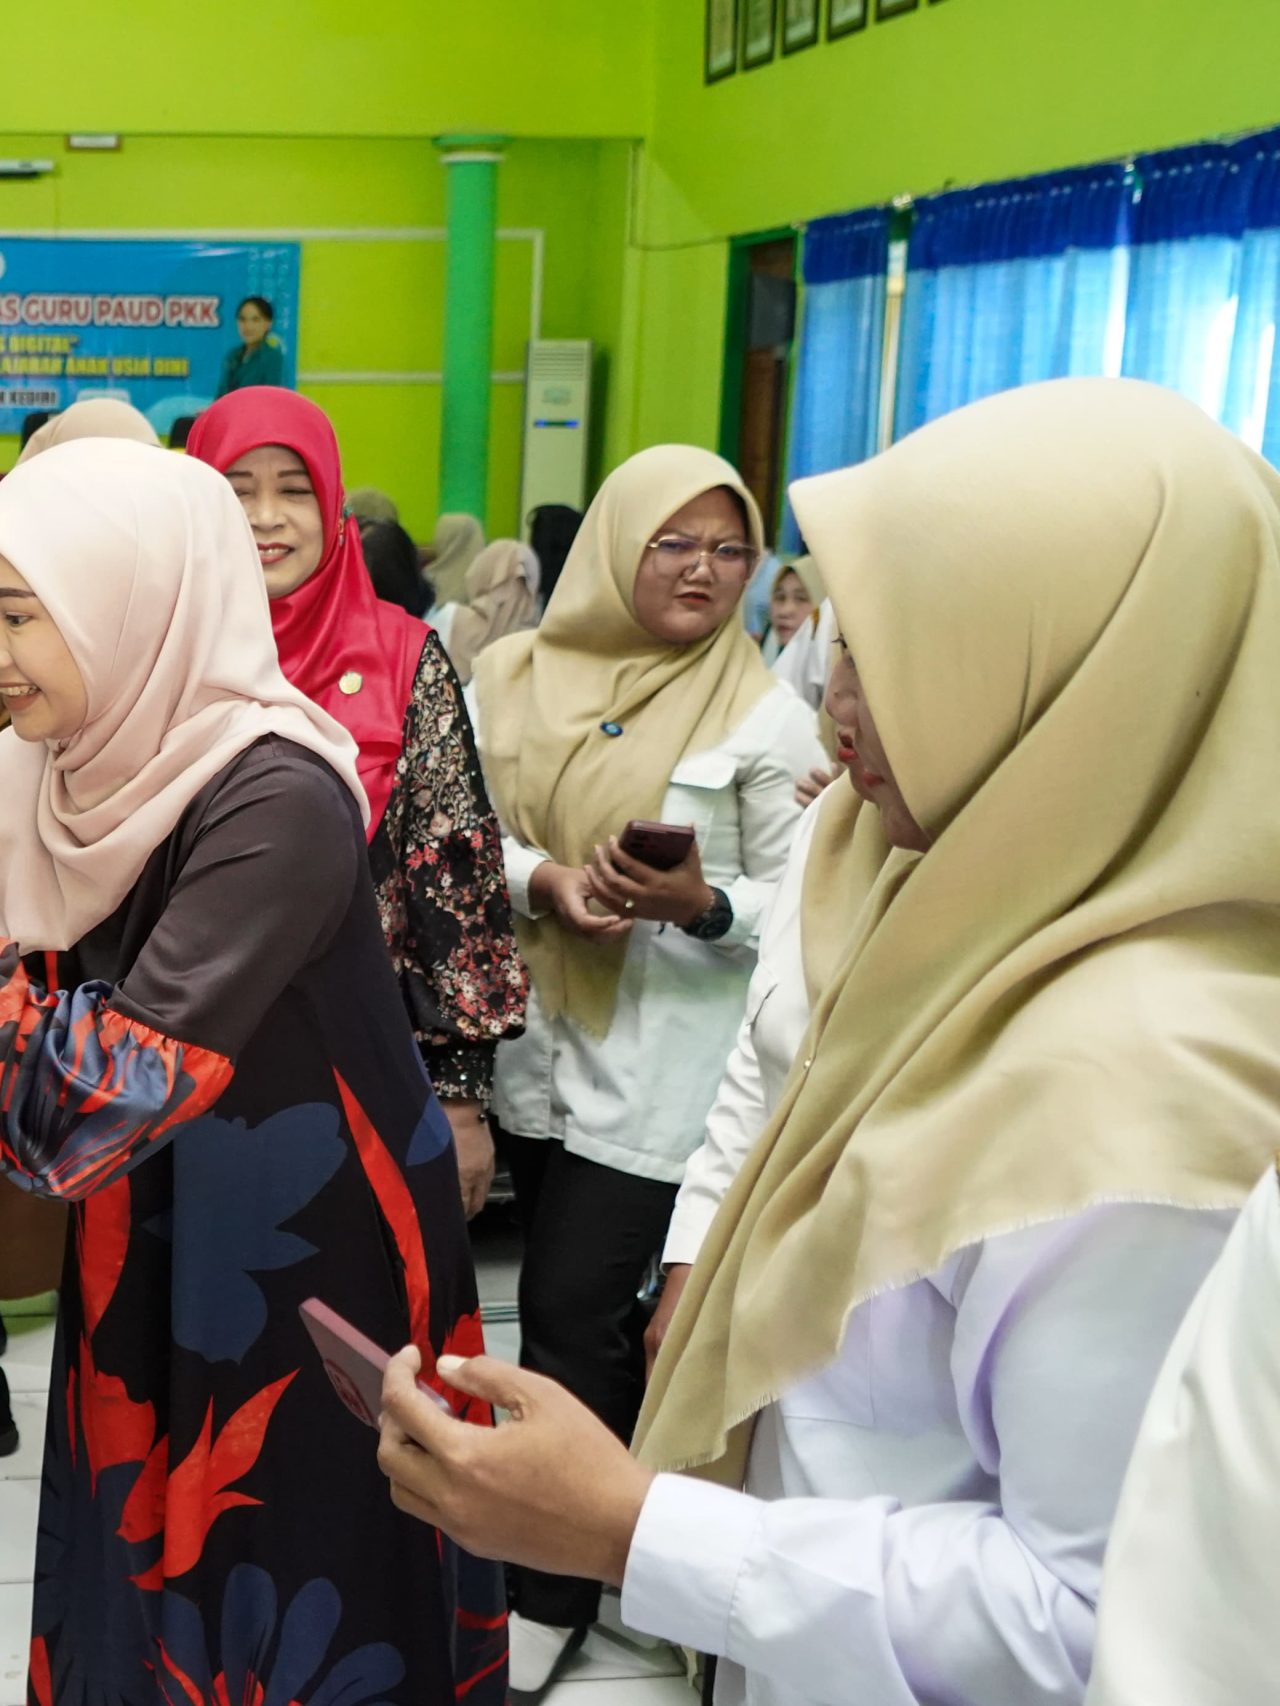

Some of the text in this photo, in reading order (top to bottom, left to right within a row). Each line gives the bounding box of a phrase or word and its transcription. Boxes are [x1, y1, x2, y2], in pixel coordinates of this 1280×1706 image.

[24, 297, 91, 323] GURU
[95, 298, 163, 324] PAUD
[167, 298, 218, 324] PKK
[8, 390, 57, 405] KEDIRI
